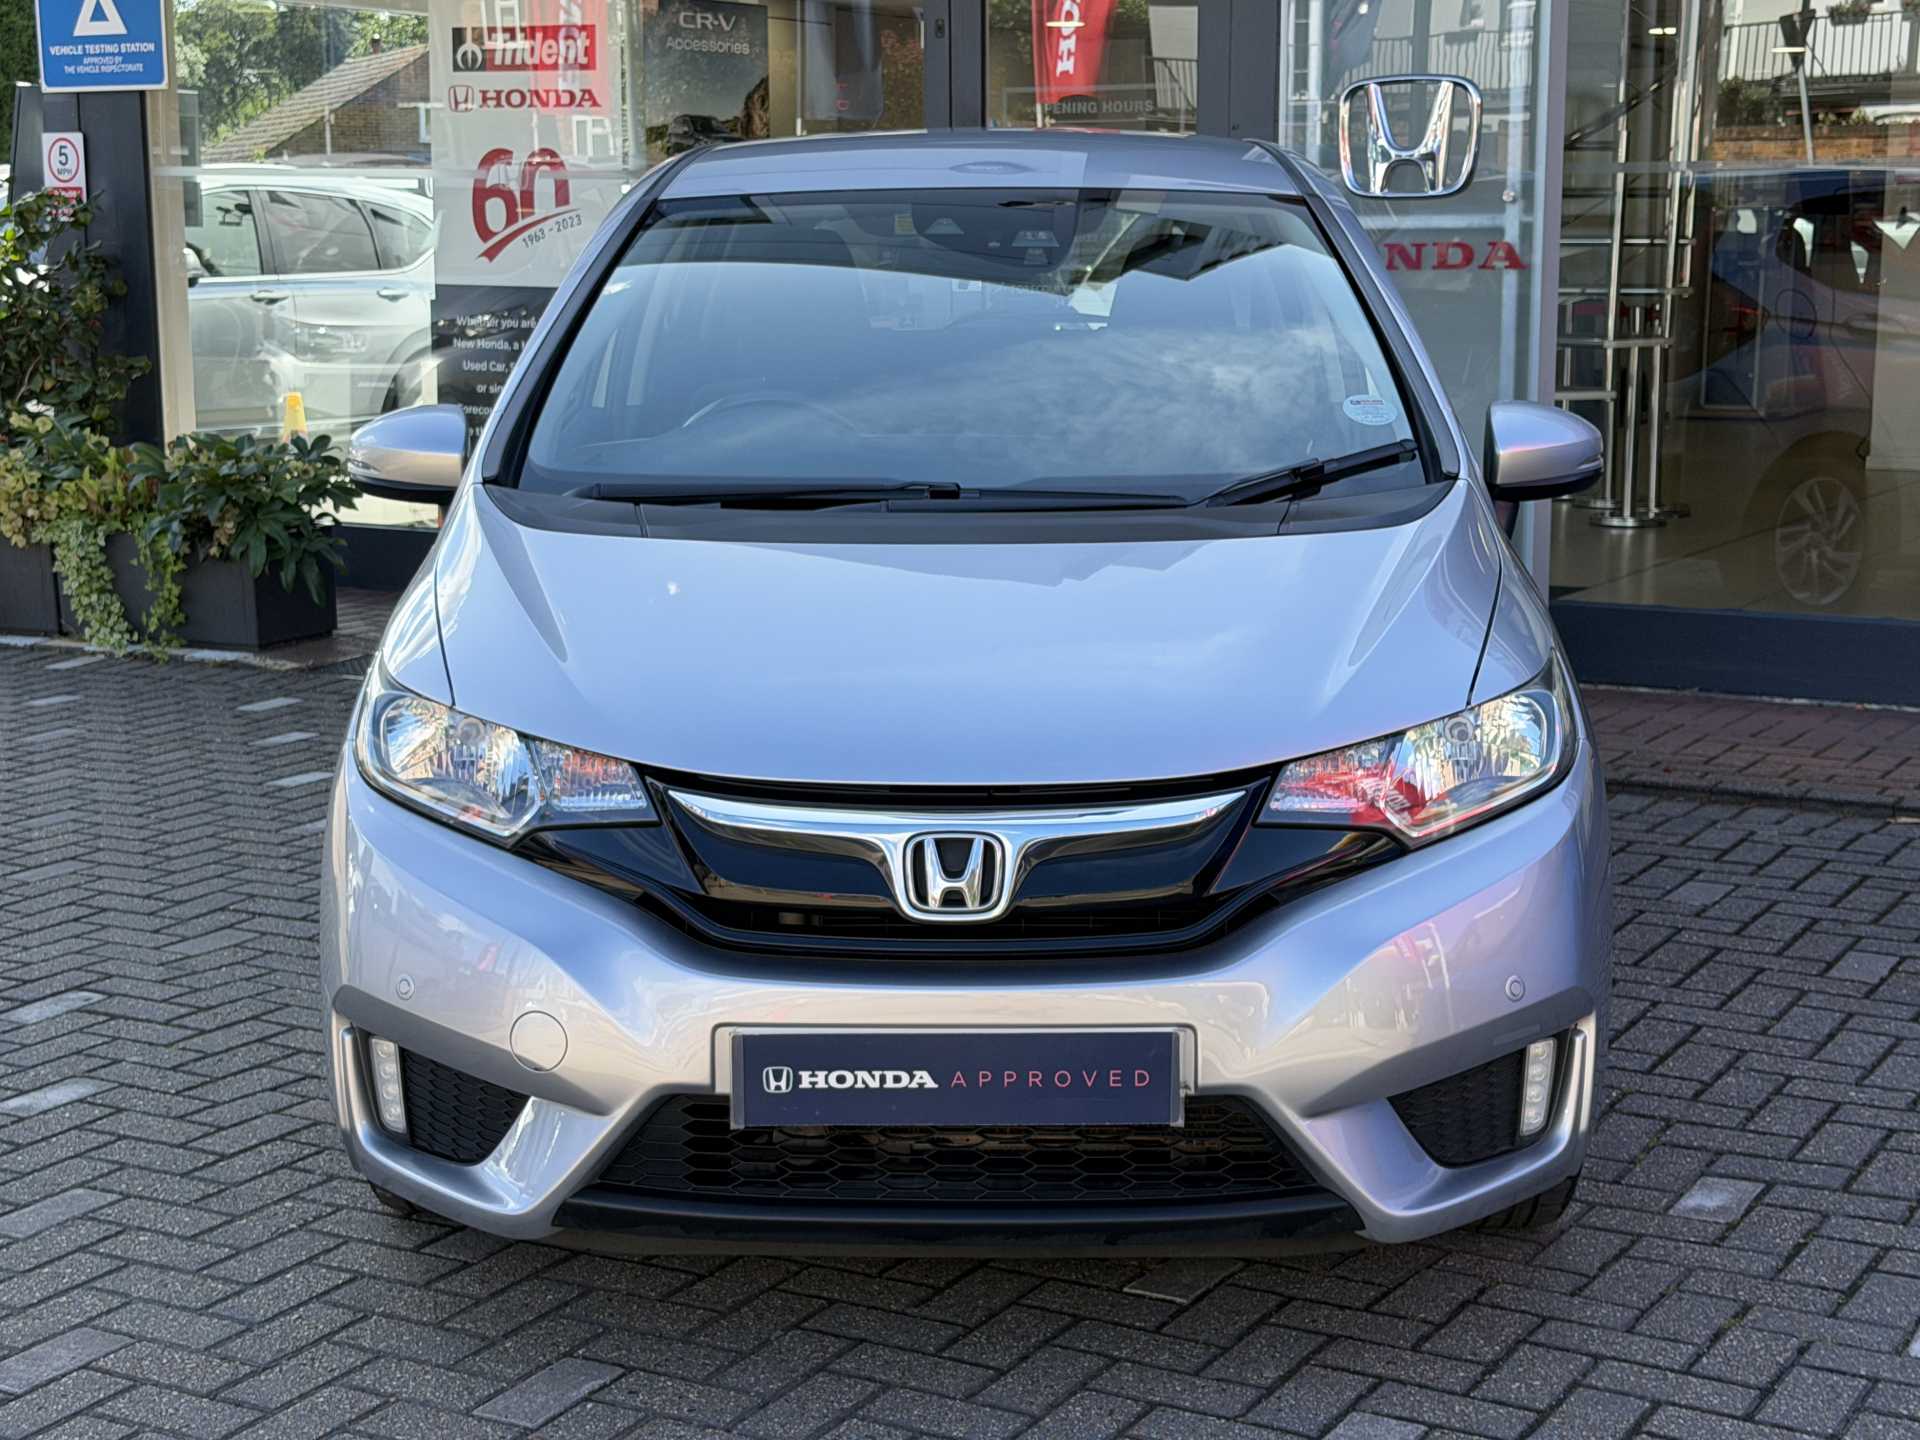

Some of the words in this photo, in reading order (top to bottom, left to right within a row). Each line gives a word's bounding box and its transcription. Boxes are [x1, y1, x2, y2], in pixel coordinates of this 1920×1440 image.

[678, 11, 737, 32] CR-V
[49, 45, 84, 56] VEHICLE
[85, 43, 119, 54] TESTING
[120, 42, 155, 53] STATION
[665, 36, 751, 55] Accessories
[83, 57, 114, 65] APPROVED
[114, 56, 124, 64] BY
[64, 65, 76, 74] THE
[77, 65, 100, 74] VEHICLE
[479, 88, 602, 109] HONDA
[1034, 101, 1098, 115] PENING
[1102, 100, 1154, 113] HOURS
[58, 144, 69, 166] 5
[57, 168, 73, 176] MPH
[522, 227, 546, 249] 1963
[555, 213, 582, 233] 2023
[1383, 240, 1529, 272] NDA
[500, 319, 519, 330] you
[453, 338, 475, 350] New
[477, 338, 511, 352] Honda,
[513, 341, 520, 351] a
[463, 360, 488, 372] Used
[476, 386, 487, 394] or
[798, 1070, 938, 1089] HONDA
[950, 1069, 1151, 1088] APPROVED
